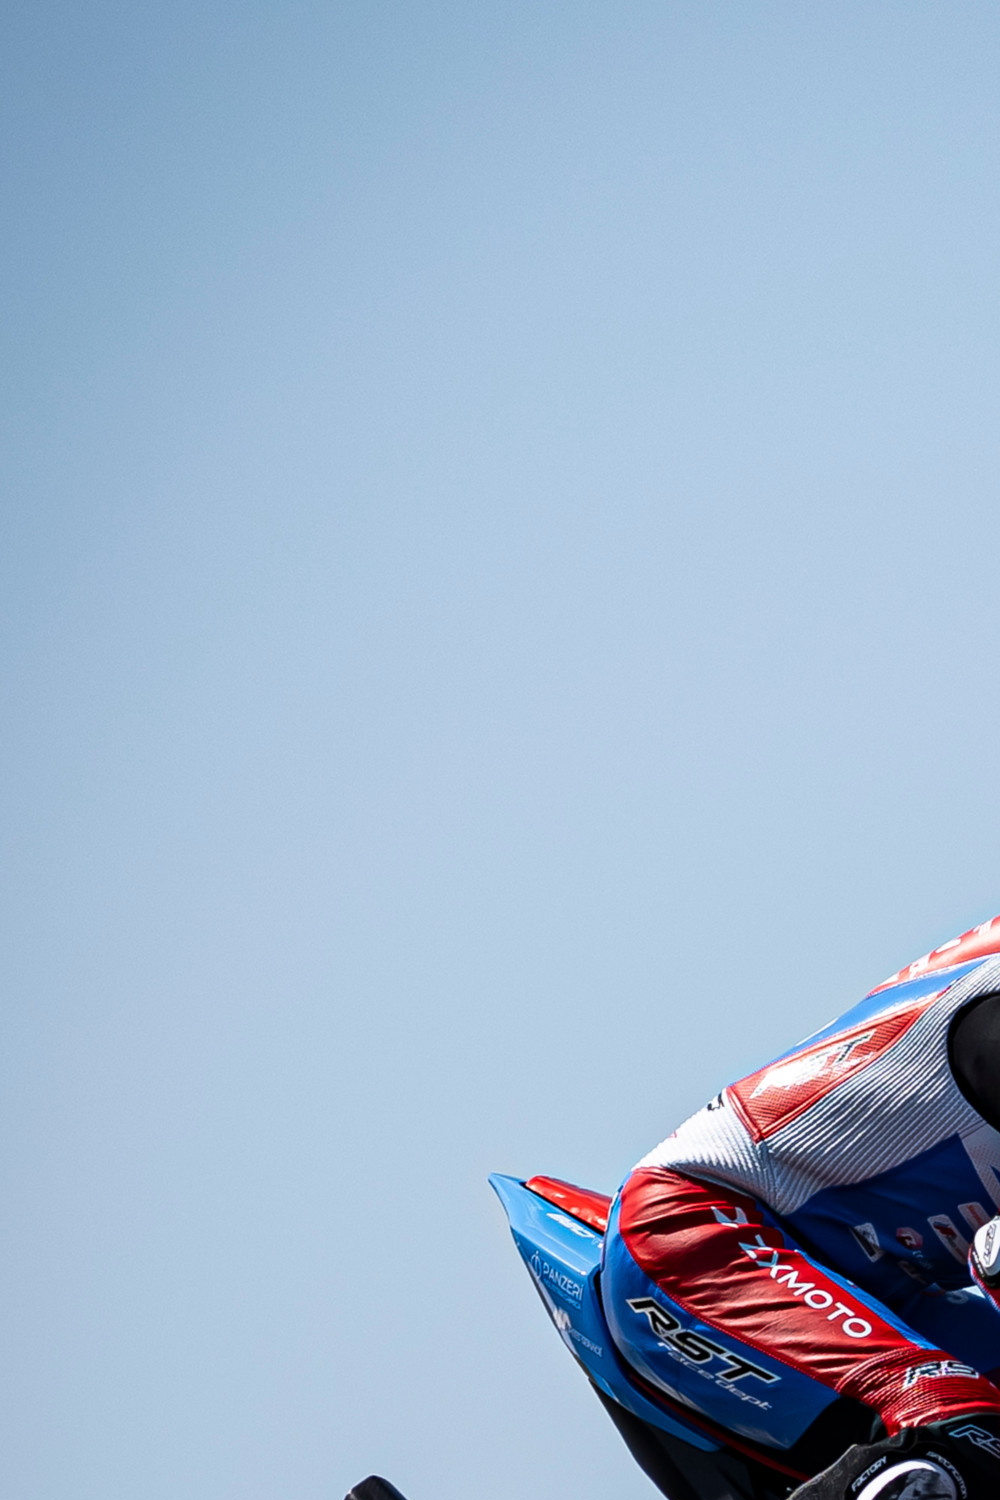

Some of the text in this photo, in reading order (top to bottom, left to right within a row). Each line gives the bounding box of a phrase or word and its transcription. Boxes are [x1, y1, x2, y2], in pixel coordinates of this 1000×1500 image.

[625, 1297, 782, 1384] RST
[714, 1379, 773, 1411] dept
[851, 1456, 887, 1492] FACTORY
